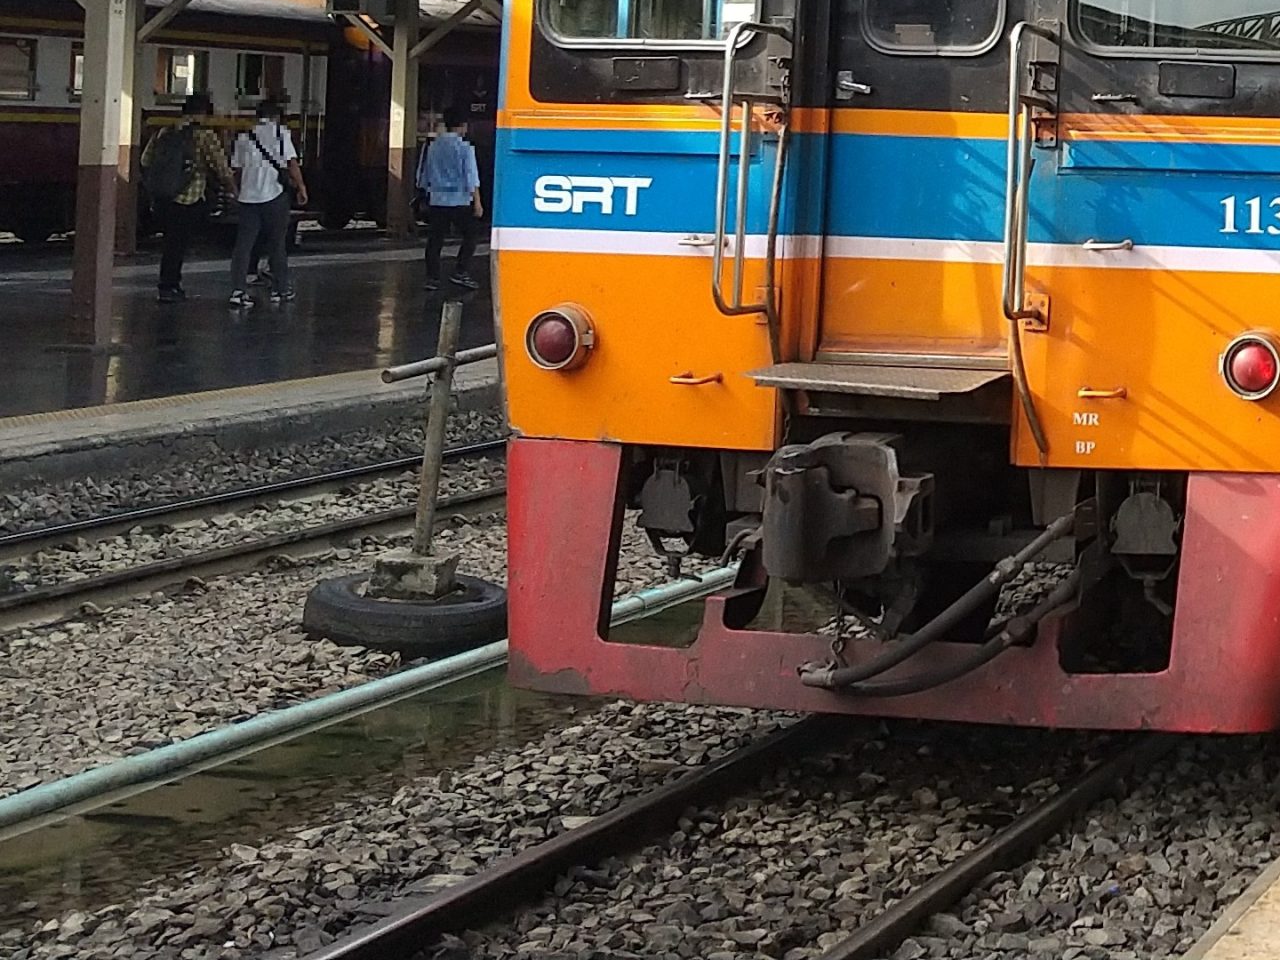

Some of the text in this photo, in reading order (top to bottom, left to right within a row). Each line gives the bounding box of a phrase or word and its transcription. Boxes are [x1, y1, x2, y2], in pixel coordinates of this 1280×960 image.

[533, 175, 653, 216] SRT
[1073, 412, 1100, 426] MR
[1075, 440, 1096, 454] BP
